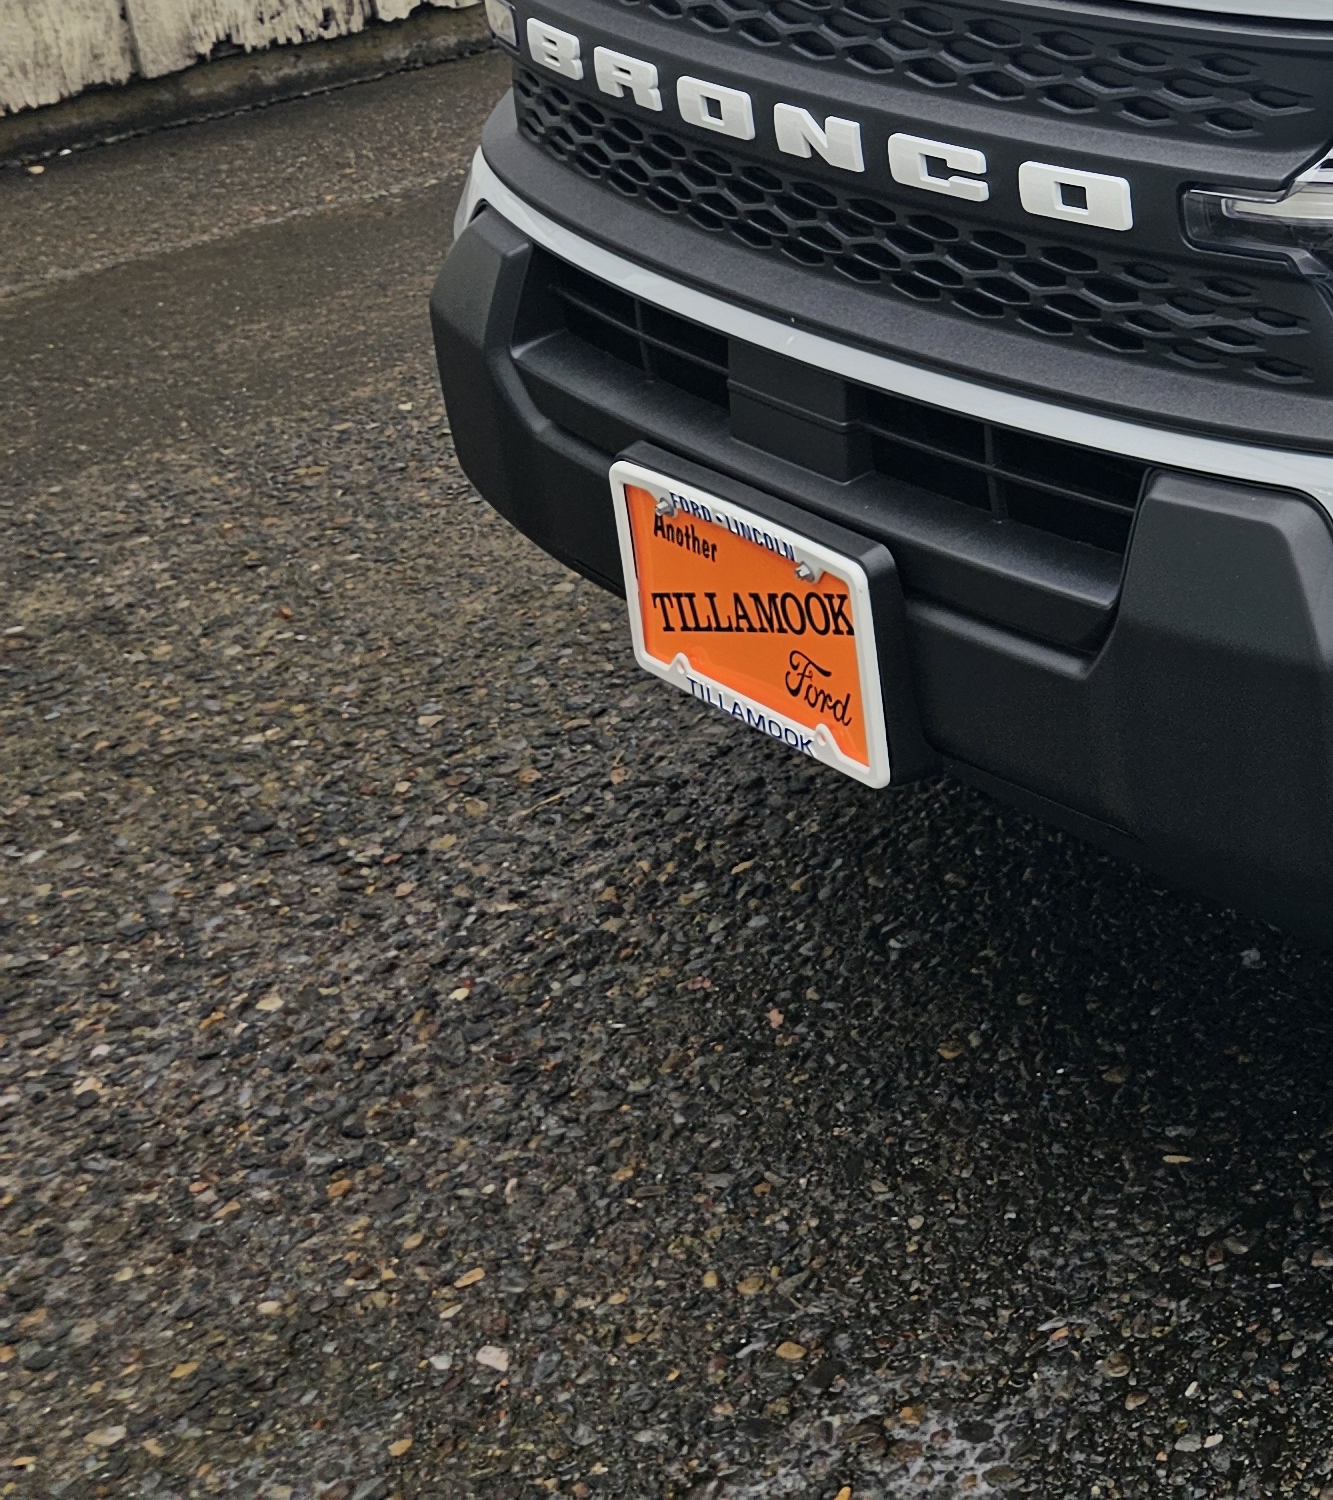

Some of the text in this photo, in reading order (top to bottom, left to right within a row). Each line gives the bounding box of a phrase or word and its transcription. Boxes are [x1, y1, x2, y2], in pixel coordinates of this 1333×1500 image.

[526, 16, 1133, 231] BRONCO
[653, 513, 718, 562] Another
[668, 490, 796, 562] FORD LINCOLN
[650, 591, 855, 637] TILLAMOOK
[685, 674, 815, 758] TILLAMOOK
[784, 649, 853, 727] Ford
